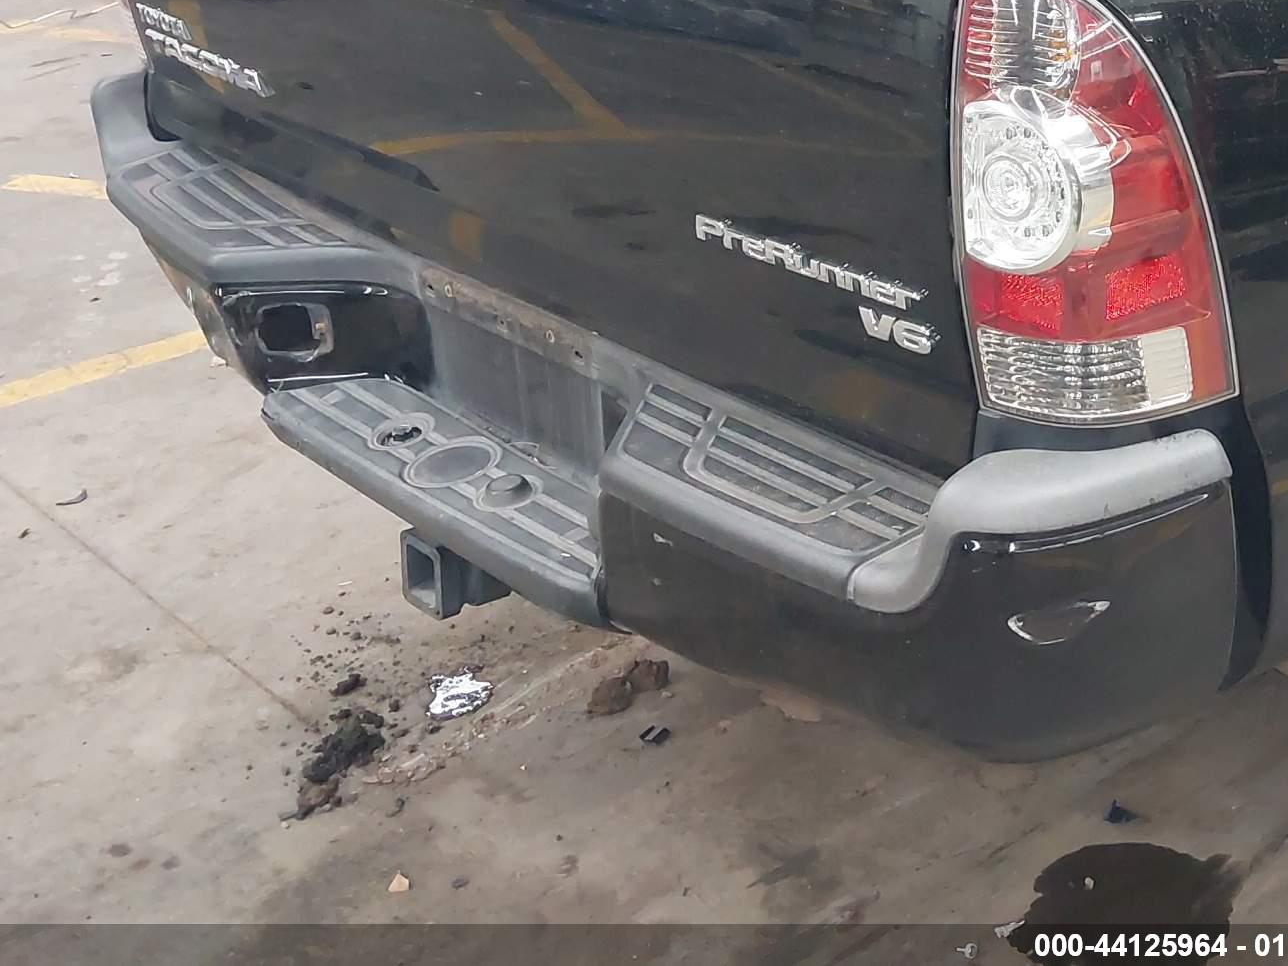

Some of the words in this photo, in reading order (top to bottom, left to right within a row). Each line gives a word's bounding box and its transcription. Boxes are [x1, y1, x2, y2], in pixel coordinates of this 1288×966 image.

[135, 2, 192, 41] TOYOTA
[144, 28, 276, 98] TACOMA
[695, 213, 929, 311] PreRunner
[858, 305, 941, 356] V6
